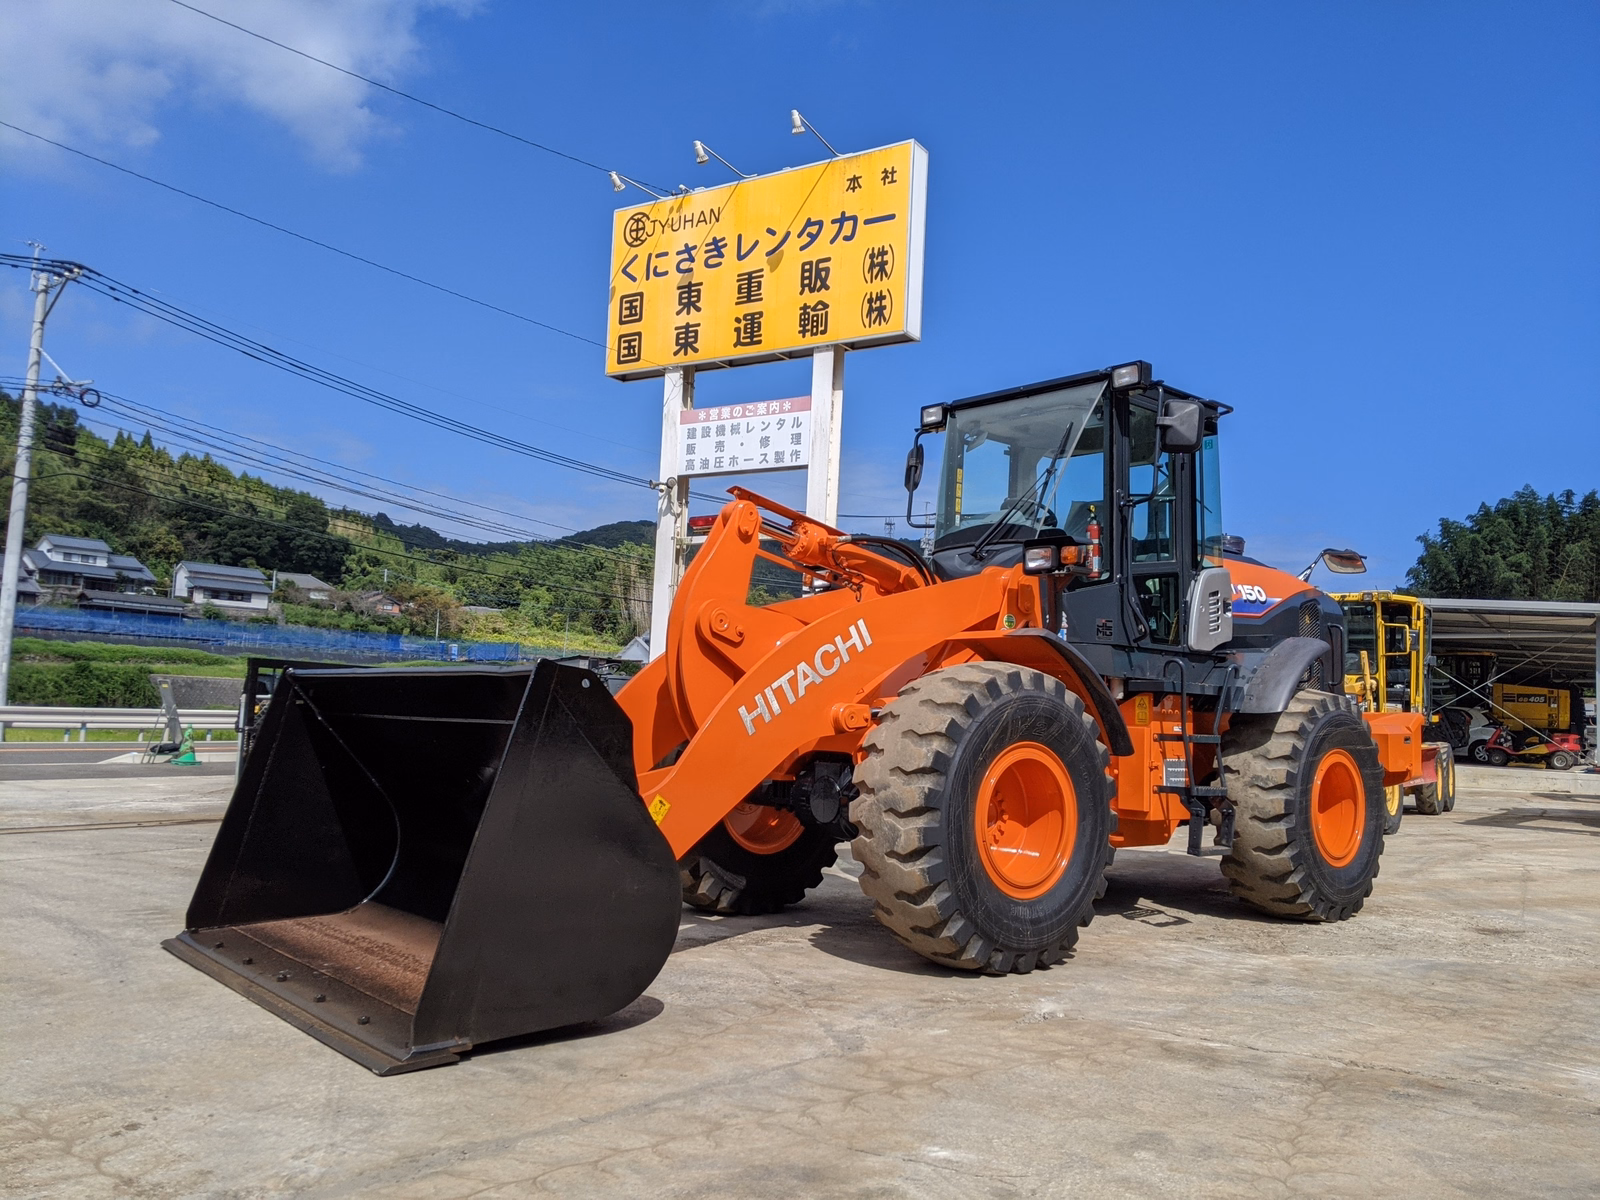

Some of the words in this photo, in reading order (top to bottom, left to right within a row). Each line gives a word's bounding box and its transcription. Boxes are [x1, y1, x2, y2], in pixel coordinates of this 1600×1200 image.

[645, 206, 721, 238] JYUHAN
[621, 210, 896, 283] くにさきレンタカー
[686, 416, 802, 440] 建設機械レンタル
[685, 449, 801, 471] 高油圧ホース製作
[737, 618, 873, 736] HITACHI
